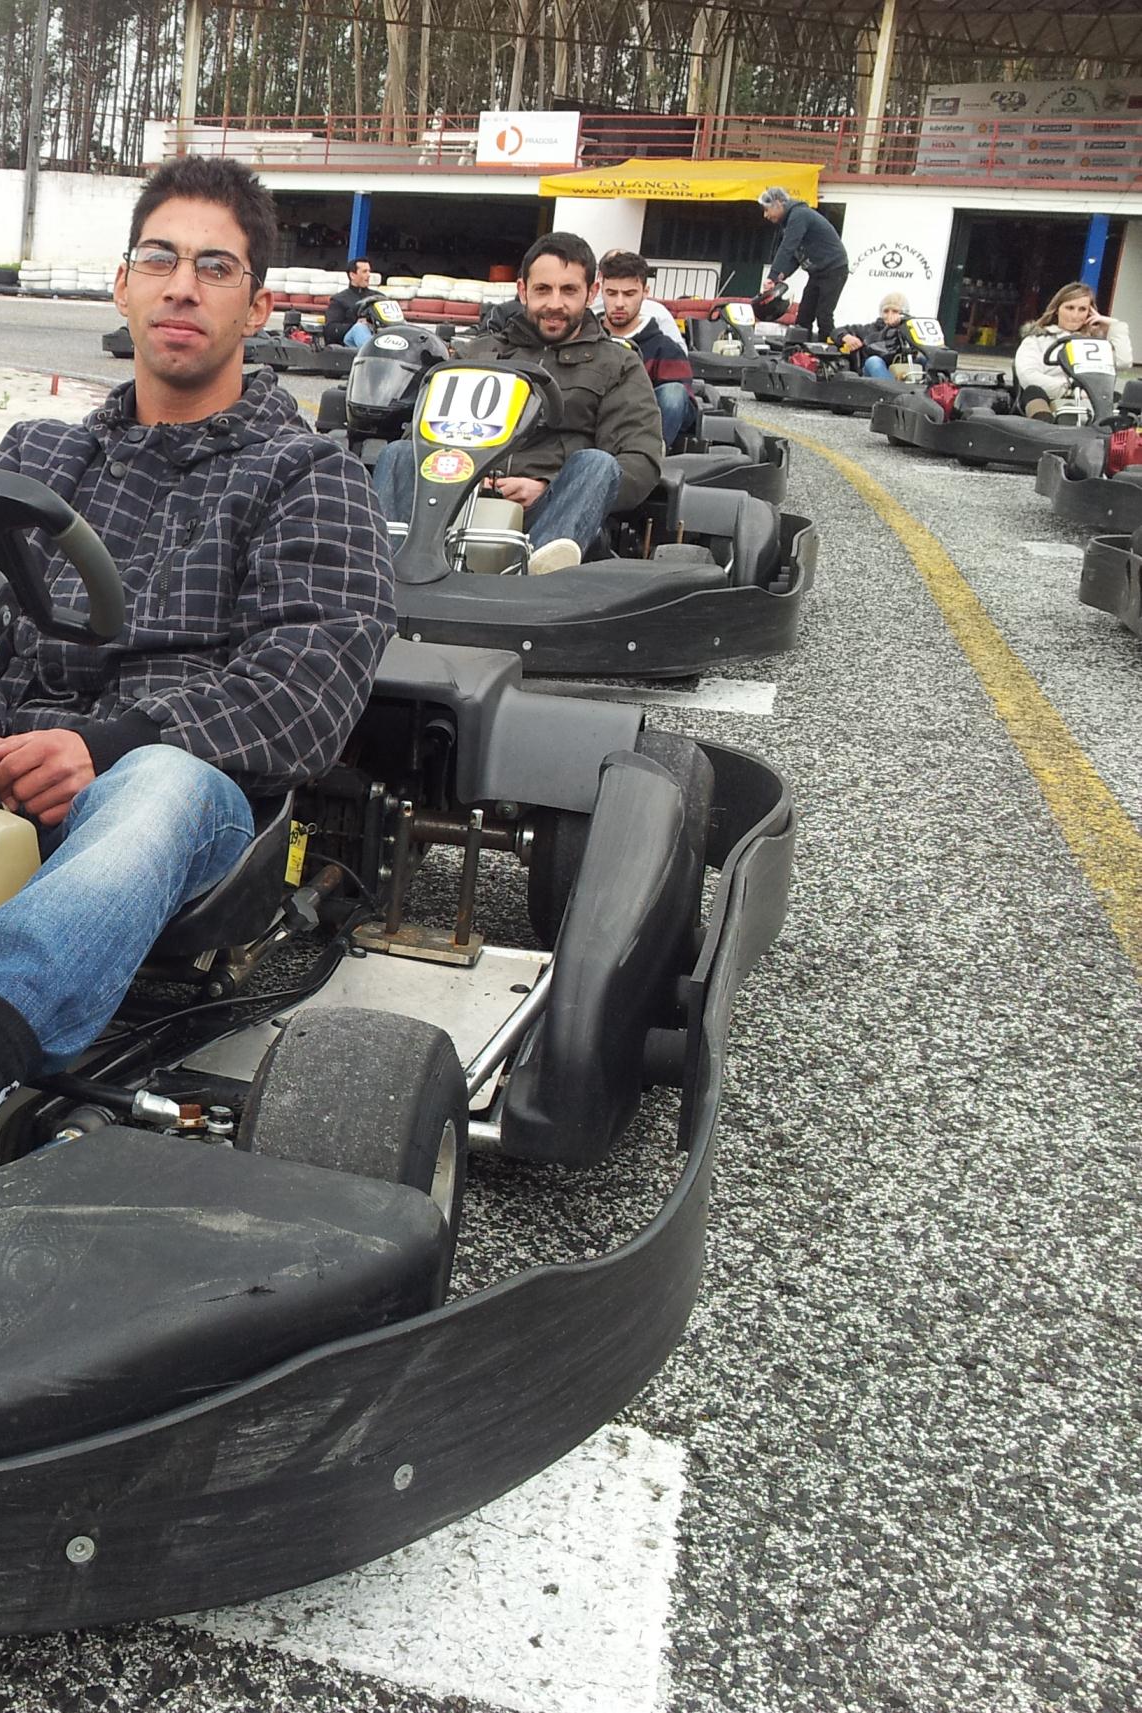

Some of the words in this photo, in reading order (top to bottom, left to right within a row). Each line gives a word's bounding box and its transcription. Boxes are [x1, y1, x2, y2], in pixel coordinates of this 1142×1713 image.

[894, 242, 933, 280] KARTING
[868, 268, 914, 280] EUROINDY
[916, 320, 939, 336] 18
[1083, 342, 1102, 361] 2
[438, 374, 502, 421] 10
